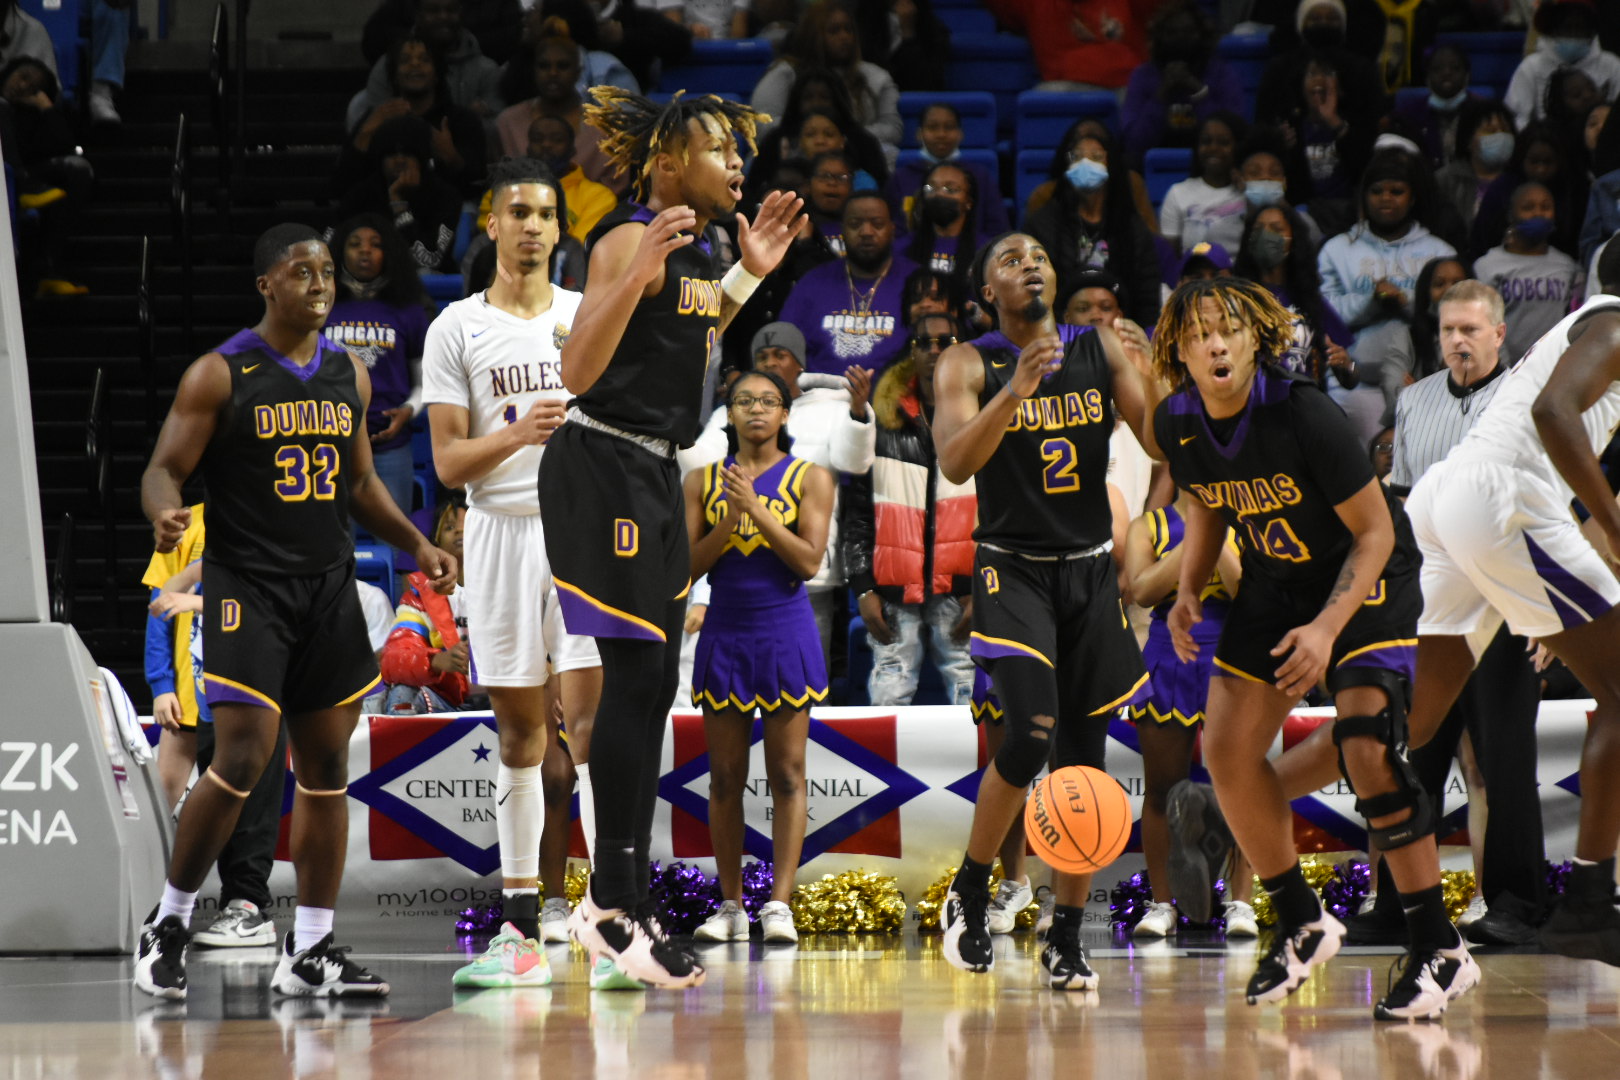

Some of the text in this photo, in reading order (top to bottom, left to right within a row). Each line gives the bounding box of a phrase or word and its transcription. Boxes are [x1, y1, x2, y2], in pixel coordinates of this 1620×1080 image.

[1502, 277, 1566, 301] BOBCAT
[490, 361, 565, 397] NOLES
[255, 400, 352, 438] DUMAS
[274, 443, 340, 502] 32
[1040, 437, 1081, 495] 2
[614, 518, 639, 557] D
[1236, 517, 1312, 563] 14
[221, 598, 241, 632] D
[0, 741, 79, 791] ZK
[1033, 783, 1062, 849] Wilson
[396, 908, 439, 918] Home
